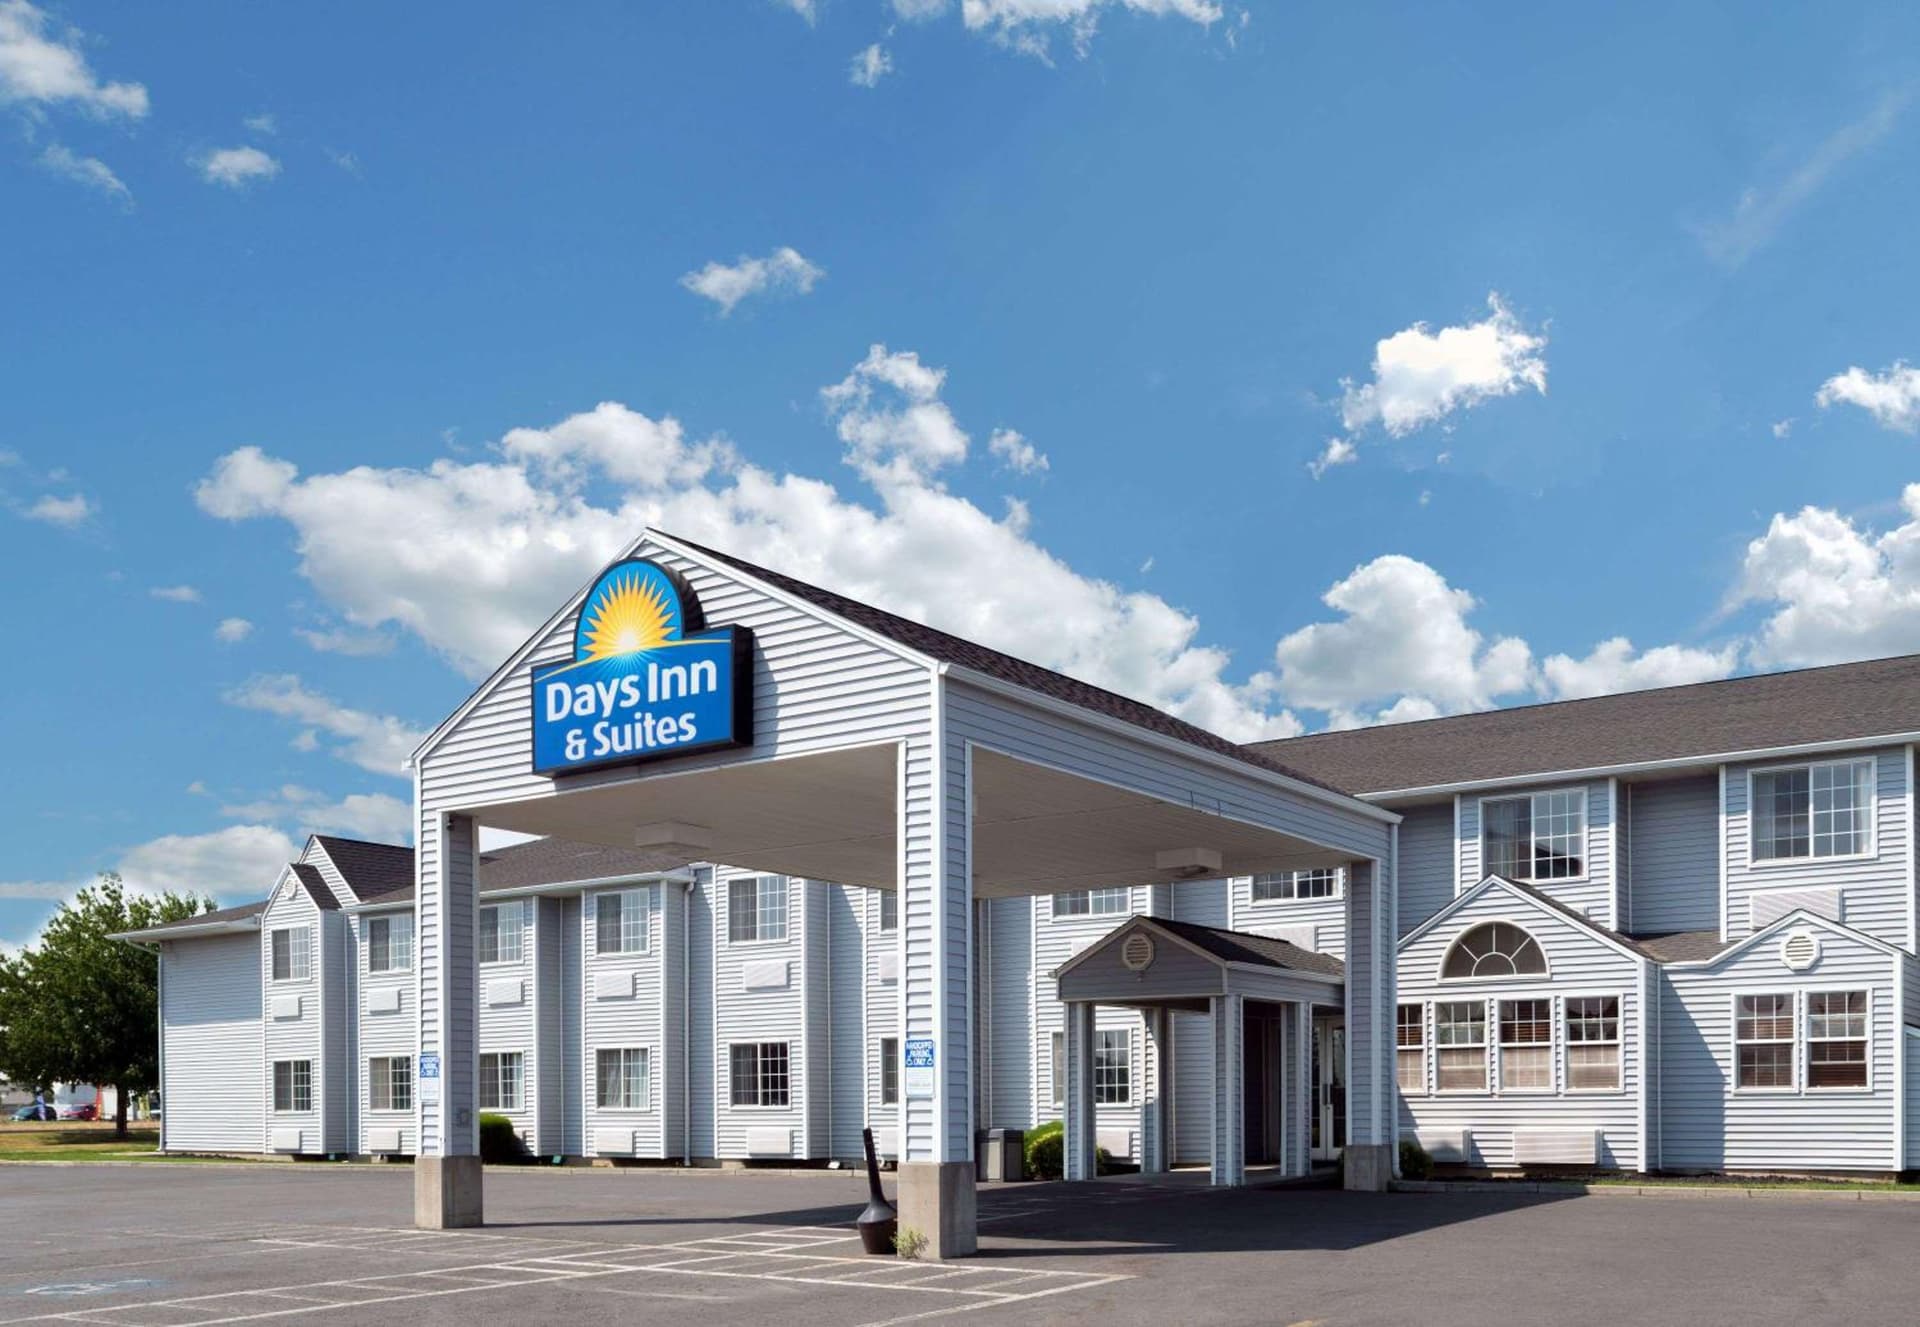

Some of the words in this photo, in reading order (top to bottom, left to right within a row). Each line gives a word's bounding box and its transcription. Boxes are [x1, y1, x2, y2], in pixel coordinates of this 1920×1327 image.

[546, 673, 641, 723] Days
[647, 658, 718, 703] Inn
[564, 728, 588, 761] &
[593, 711, 698, 757] Suites
